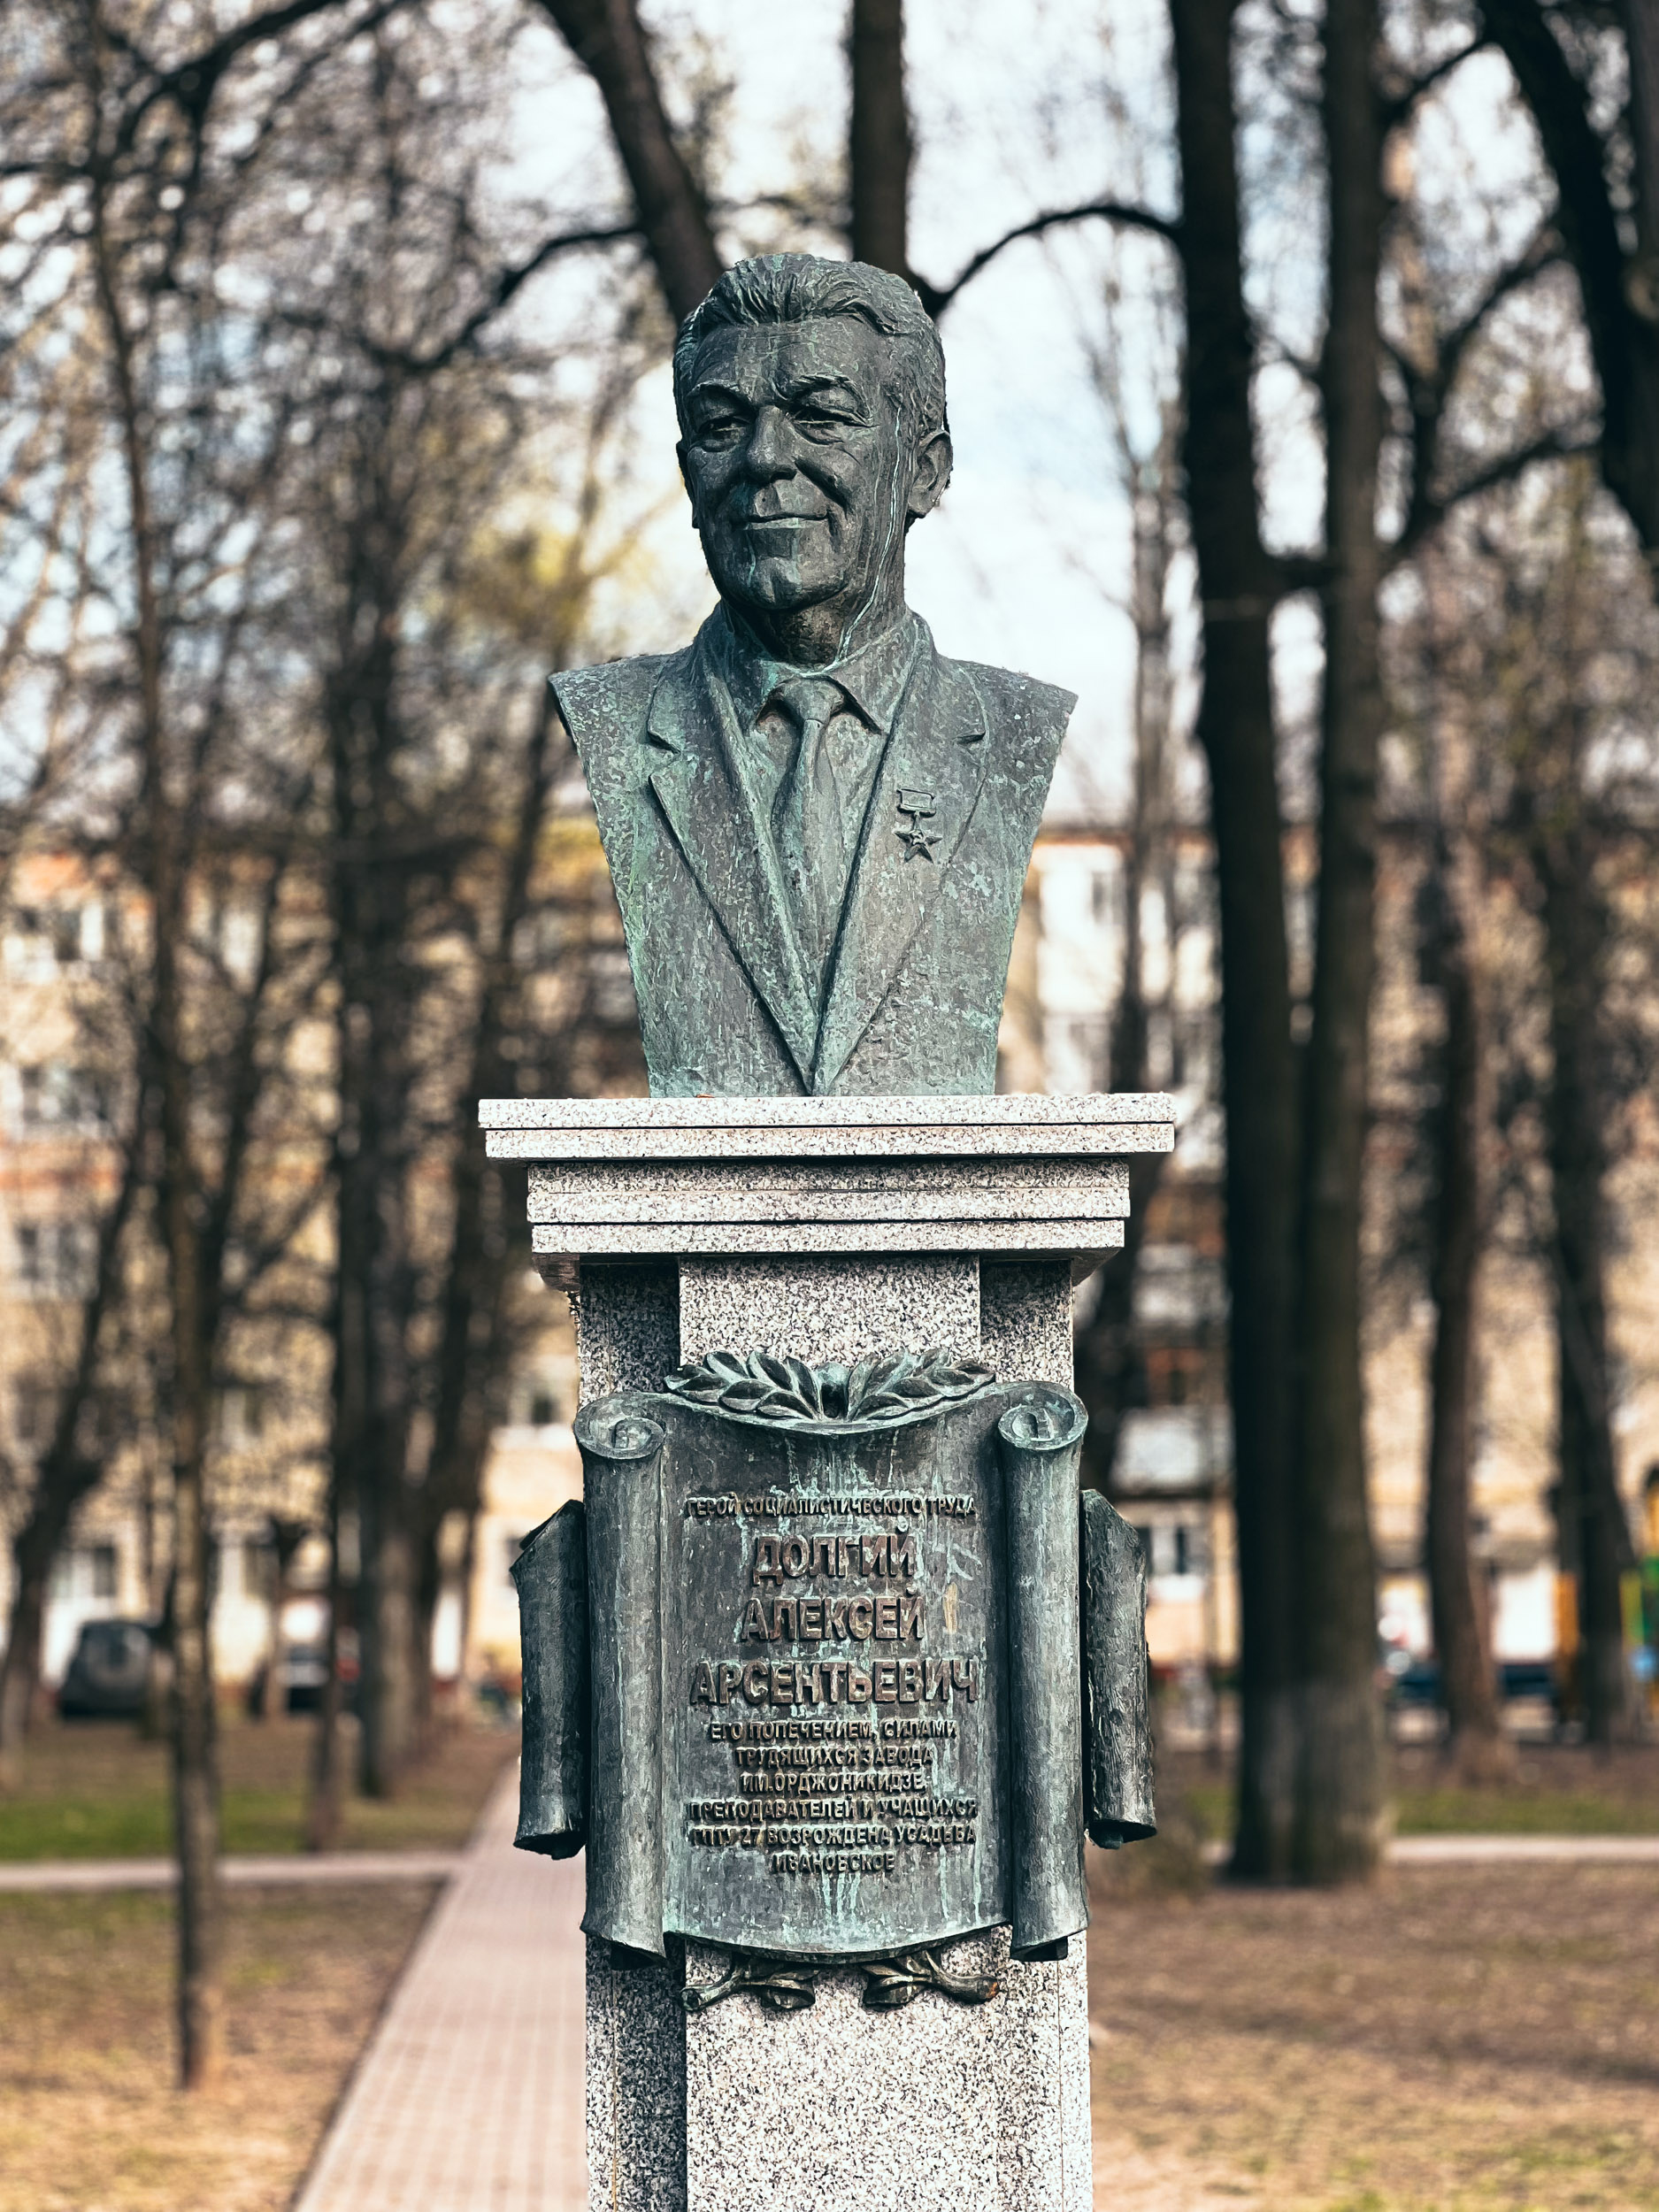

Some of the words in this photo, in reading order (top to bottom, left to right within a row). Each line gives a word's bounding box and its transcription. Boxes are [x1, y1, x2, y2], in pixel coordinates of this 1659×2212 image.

[686, 1491, 741, 1517] ГЕРОЙ
[743, 1495, 924, 1517] СОЦИАЛИСТИЧЕСКОГО
[927, 1495, 976, 1517] ТРУДА
[753, 1522, 918, 1586] ДОЛГИЙ
[741, 1582, 926, 1641] АЛЕКСЕЙ
[689, 1658, 980, 1705] АРСЕНТЬЕВИЧ
[710, 1721, 743, 1740] ЕГО
[883, 1718, 957, 1739] СИЛАМИ
[736, 1747, 858, 1768] ТРУДЯЩИХСЯ
[861, 1745, 933, 1768] ЗАВОДА
[689, 1795, 859, 1822] ПРЕПОДАВАТЕЛЕЙ
[861, 1798, 873, 1818] И
[877, 1797, 979, 1819] УЧАЩИХСЯ
[692, 1826, 738, 1847] ГПТУ
[740, 1825, 762, 1846] 27
[766, 1824, 893, 1848] ВОЗРОЖДЕНА
[894, 1824, 977, 1847] УСАДЬБА
[769, 1851, 896, 1874] ИВАНОВСКОЕ
